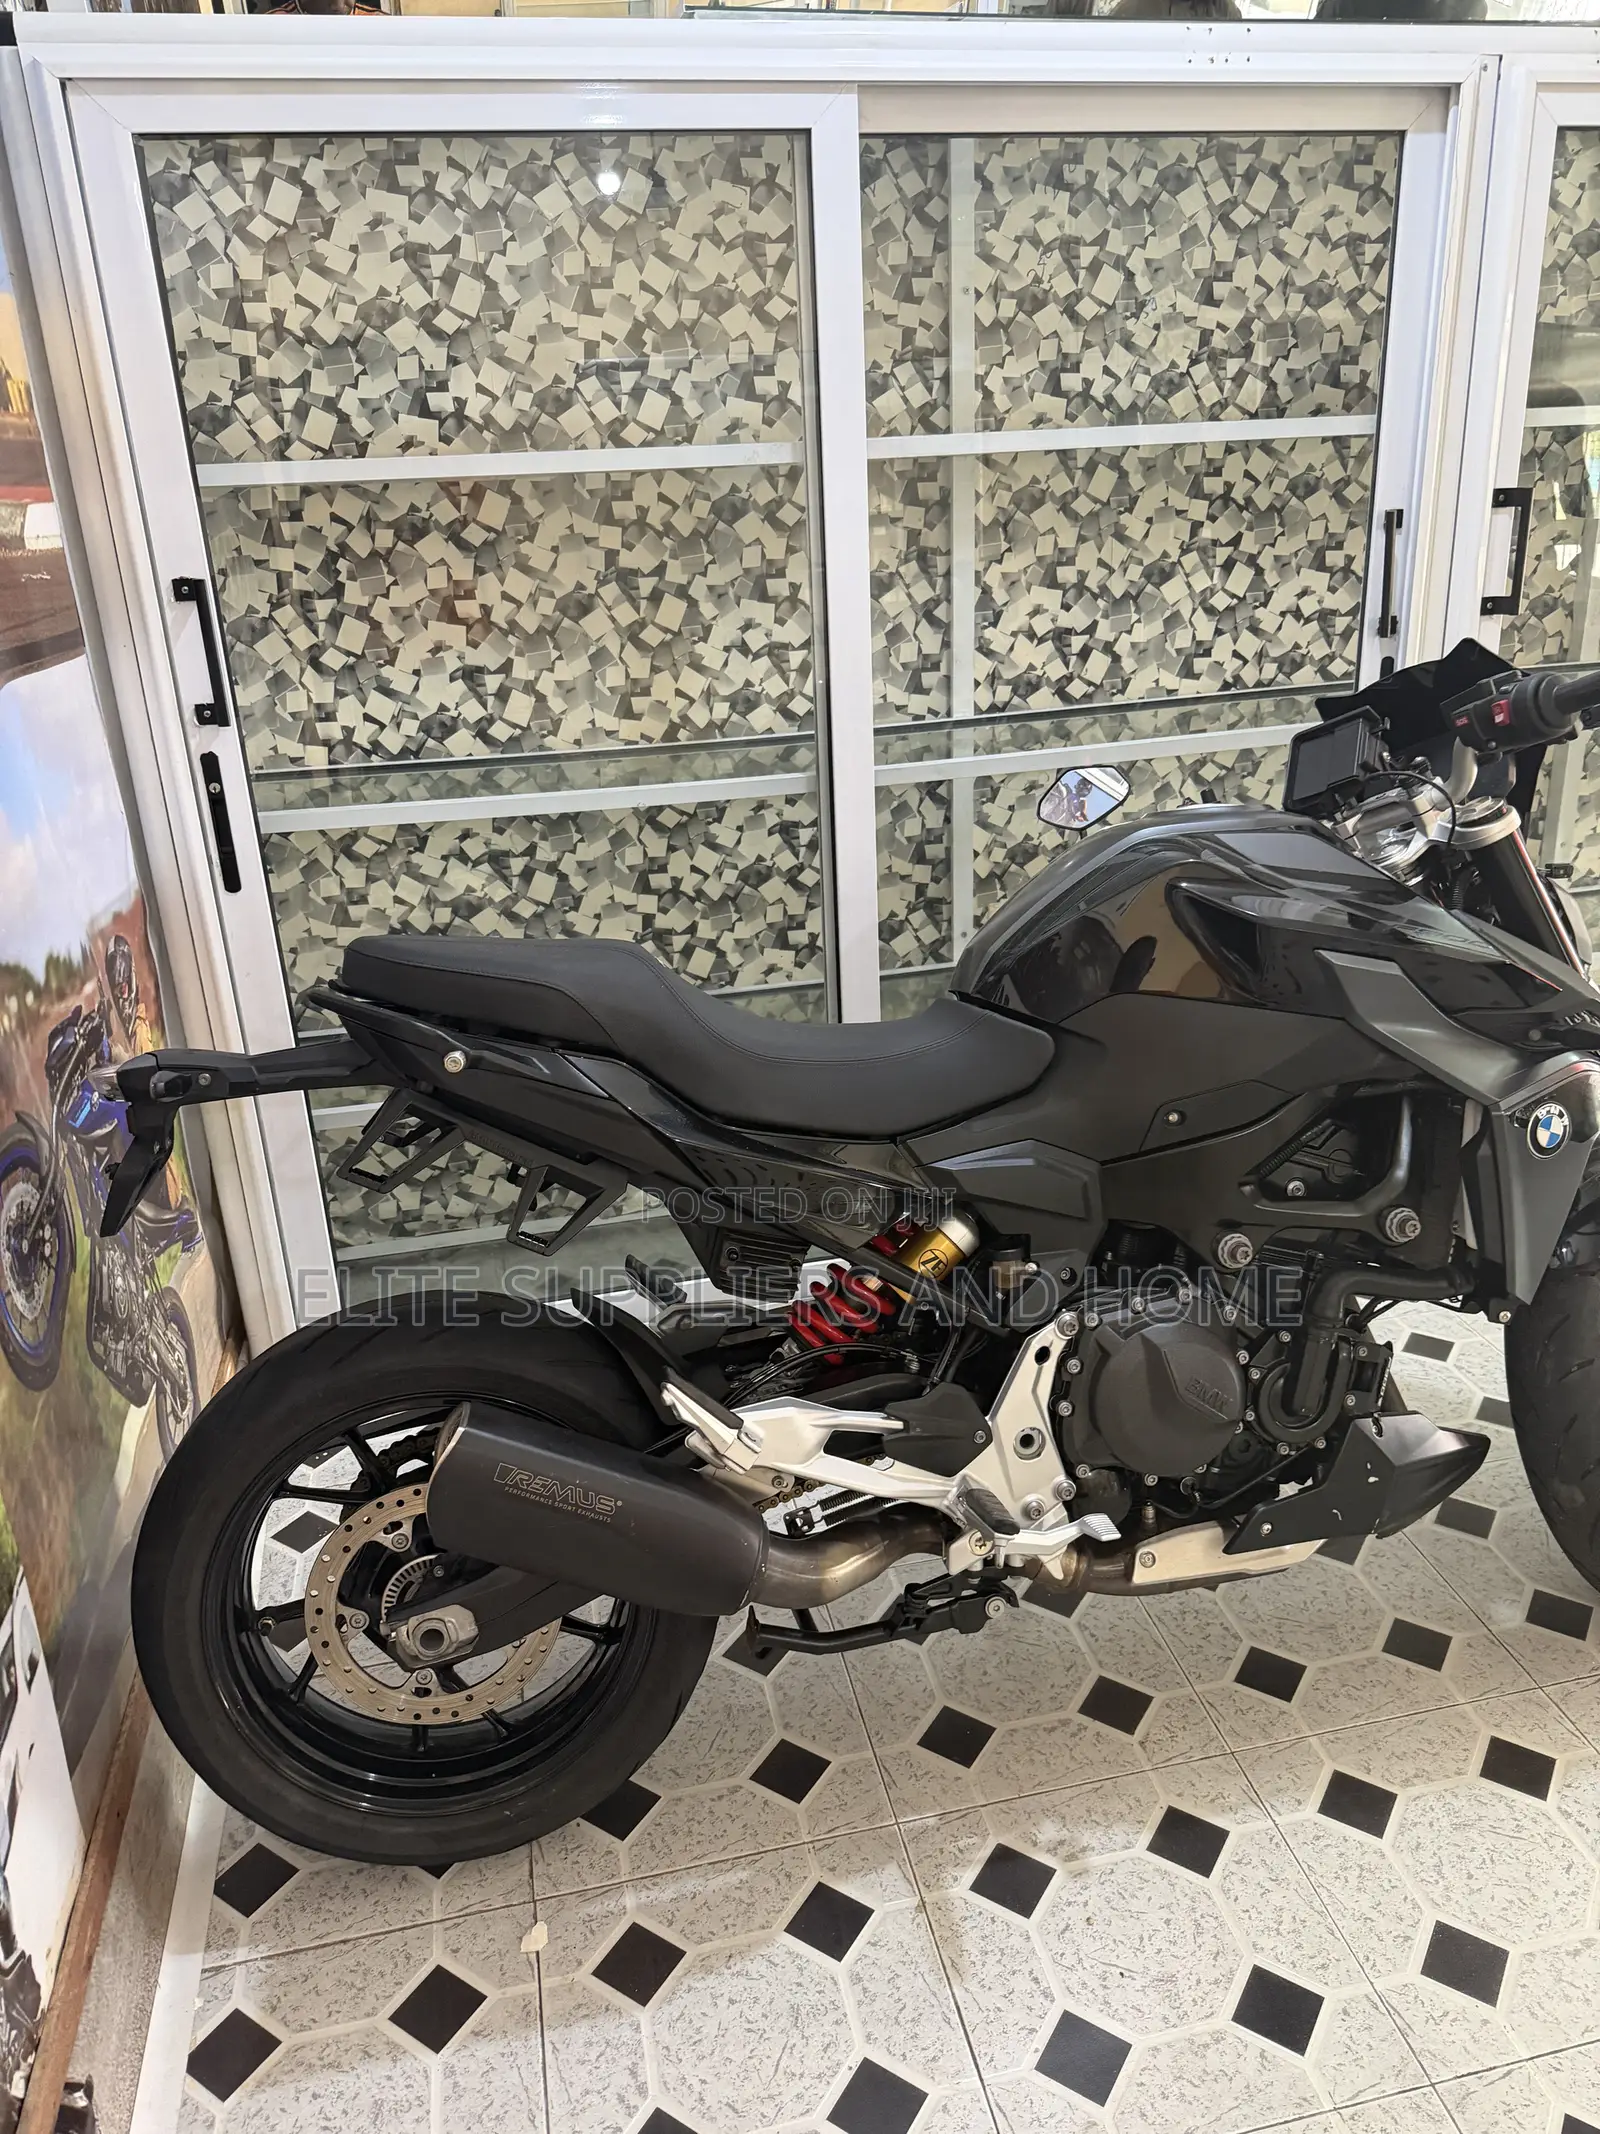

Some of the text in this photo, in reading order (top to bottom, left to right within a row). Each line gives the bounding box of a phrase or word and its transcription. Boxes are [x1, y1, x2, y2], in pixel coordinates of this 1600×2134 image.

[920, 1249, 948, 1278] ZF
[504, 1486, 612, 1523] PERFORMANCE SPORT EXHAUSTS
